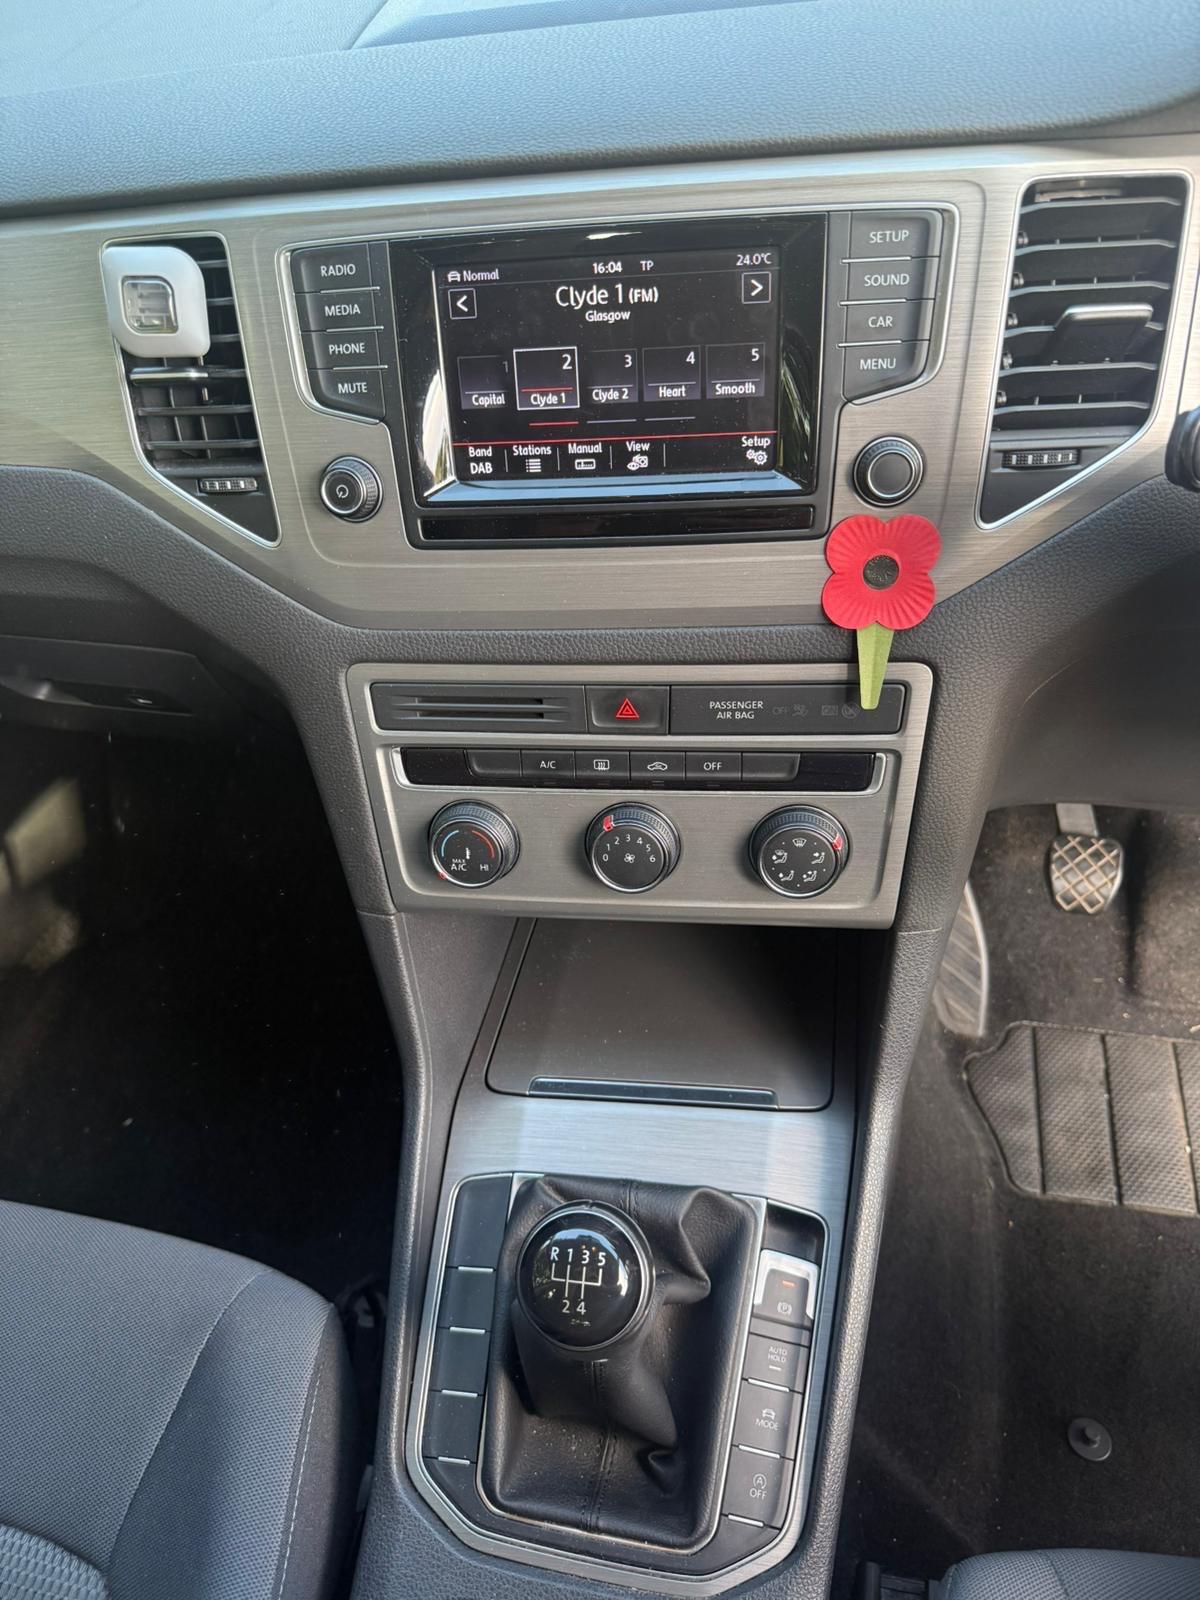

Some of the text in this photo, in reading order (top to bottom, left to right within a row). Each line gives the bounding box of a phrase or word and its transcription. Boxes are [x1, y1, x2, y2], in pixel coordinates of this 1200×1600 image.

[869, 230, 909, 243] SETUP
[320, 264, 356, 277] RADIO
[592, 261, 623, 274] 16:04
[640, 261, 654, 271] TP
[463, 269, 500, 282] Normal
[864, 274, 910, 286] SOUND
[555, 284, 659, 309] Clyde 1 (FM)
[324, 304, 361, 317] MEDIA
[585, 310, 631, 324] Glasgow
[868, 316, 893, 328] CAR
[328, 343, 365, 355] PHONE
[751, 348, 760, 362] 5
[561, 354, 573, 370] 2
[624, 354, 633, 368] 3
[686, 351, 696, 365] 4
[859, 358, 896, 370] MENU
[338, 382, 368, 394] MUTE
[658, 385, 687, 398] Heart
[715, 382, 756, 396] Smooth
[472, 393, 506, 407] Capital
[530, 392, 566, 407] Clyde 1
[592, 388, 629, 403] Clyde 2
[568, 442, 602, 454] Manual
[626, 440, 650, 452] View
[741, 435, 771, 449] Setup
[468, 446, 492, 458] Band
[512, 444, 552, 456] Stations
[470, 462, 493, 474] DAB
[709, 701, 764, 709] PASSENGER
[716, 711, 755, 720] AIR BAG
[539, 760, 557, 770] A/C
[703, 762, 722, 771] OFF
[450, 863, 468, 872] A/C
[479, 864, 489, 872] HI
[550, 1246, 559, 1261] R
[567, 1248, 573, 1262] 1
[581, 1250, 590, 1264] 3
[597, 1252, 606, 1266] 5
[562, 1300, 570, 1313] 2
[576, 1301, 586, 1315] 4
[769, 1346, 787, 1356] AUTO
[768, 1353, 787, 1363] HOLD
[755, 1418, 780, 1431] MODE
[749, 1487, 767, 1500] OFF
